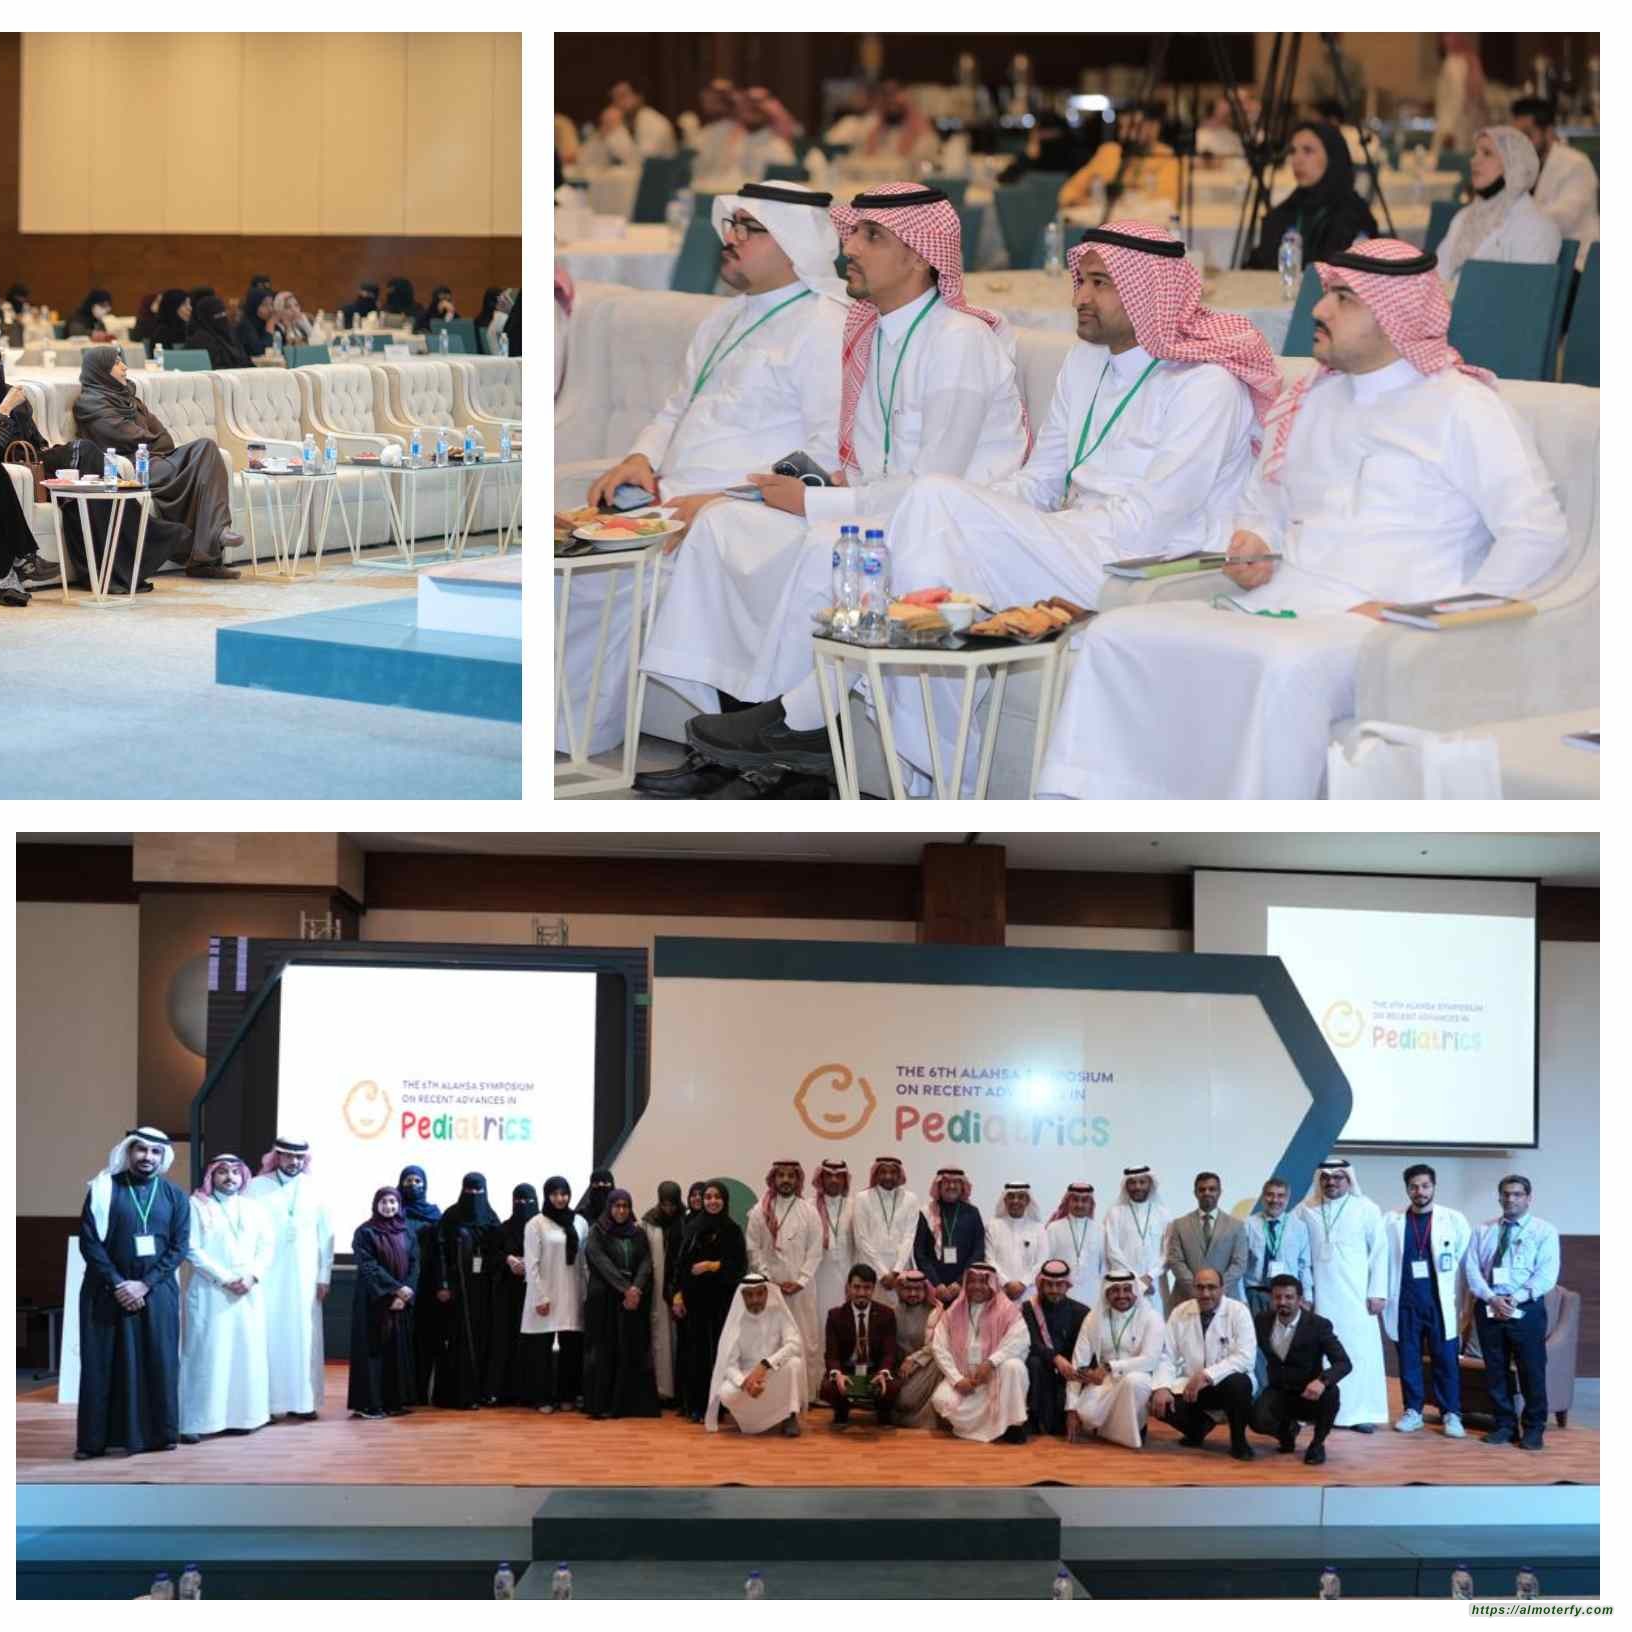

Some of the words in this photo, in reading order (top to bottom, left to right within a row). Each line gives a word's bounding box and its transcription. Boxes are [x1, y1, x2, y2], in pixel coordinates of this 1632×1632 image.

[896, 1066, 925, 1078] THE
[929, 1066, 956, 1079] 6TH
[402, 1079, 419, 1090] THE
[479, 1081, 534, 1092] SYMPOSIUM
[896, 1084, 919, 1096] ON
[923, 1085, 985, 1097] RECENT
[402, 1094, 416, 1104] ON
[418, 1094, 454, 1104] RECENT
[455, 1095, 505, 1105] ADVANCES
[507, 1095, 517, 1104] IN
[401, 1110, 532, 1141] Pediatrics
[895, 1105, 1111, 1147] Pediarics
